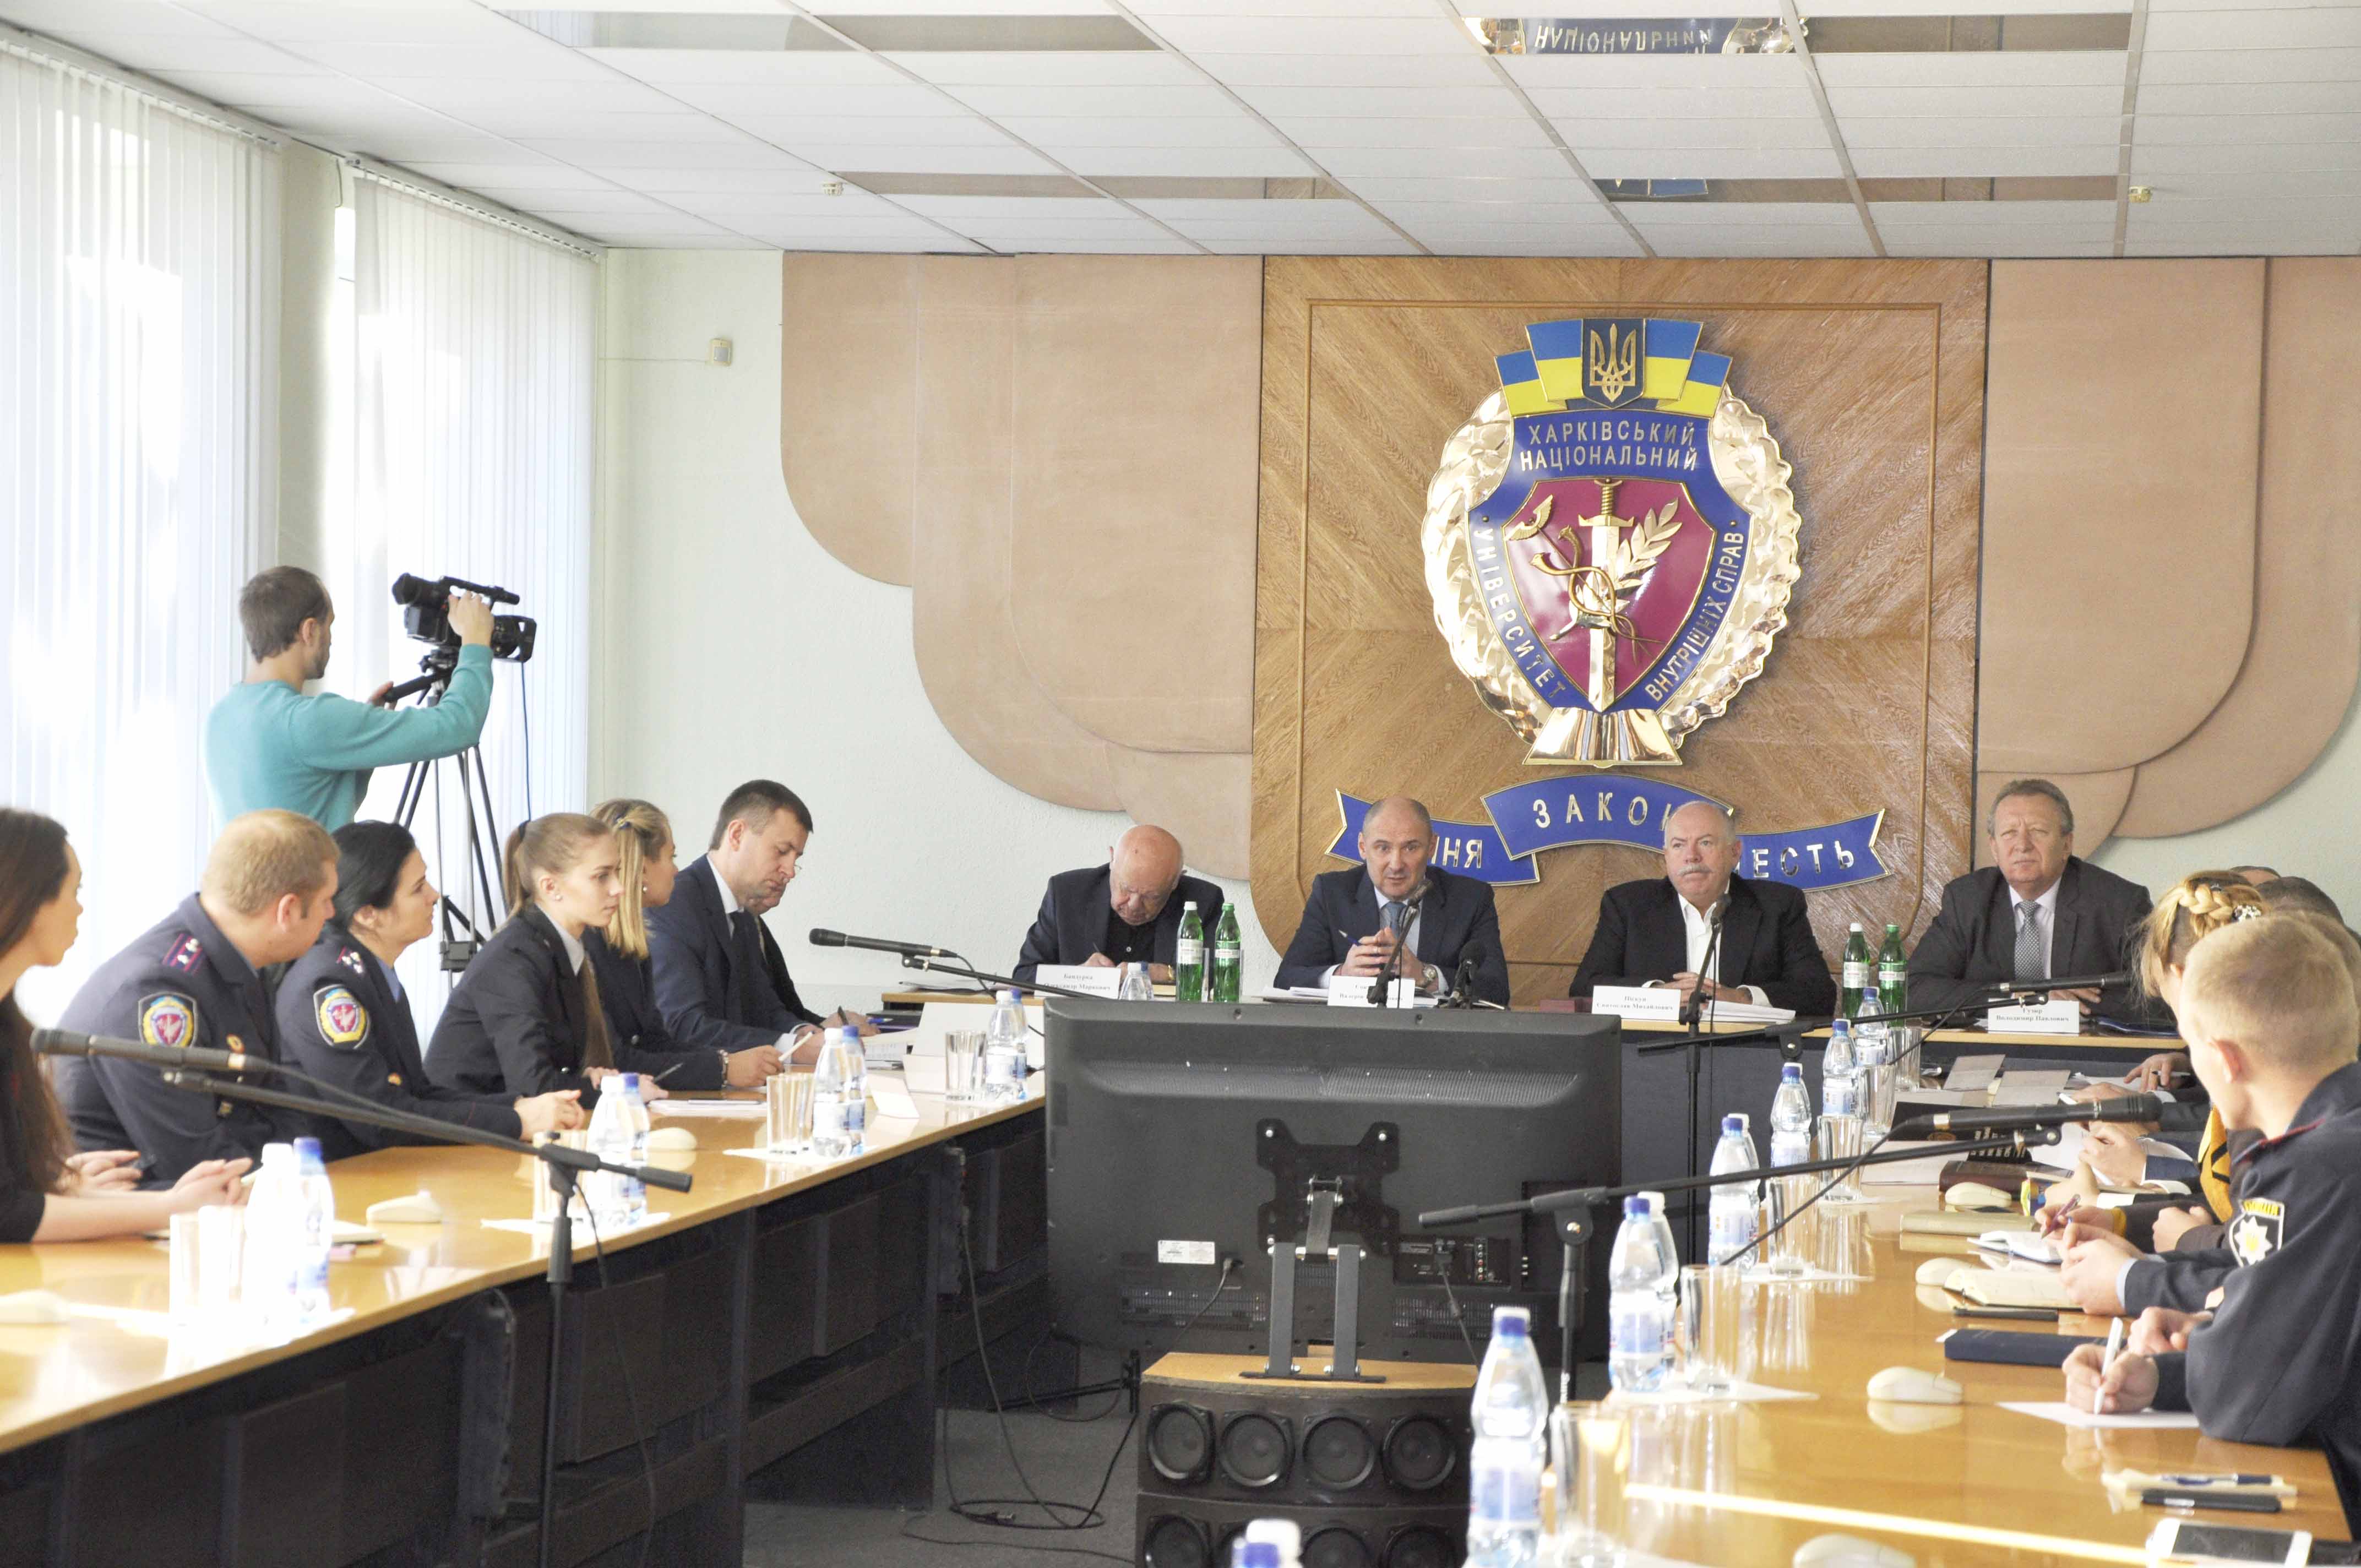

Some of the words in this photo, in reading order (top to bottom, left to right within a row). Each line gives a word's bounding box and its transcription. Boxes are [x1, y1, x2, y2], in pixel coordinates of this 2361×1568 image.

[1528, 420, 1696, 447] ХАРКІВСЬКИЙ
[1520, 445, 1698, 472] НАЦІОНАЛЬНИЙ
[1472, 527, 1566, 699] УНІВЕРСИТЕТ
[1645, 596, 1724, 702] ВНУТРІШНІХ
[1711, 531, 1744, 592] СПРАВ
[1734, 840, 1854, 878] ЕСТЬ
